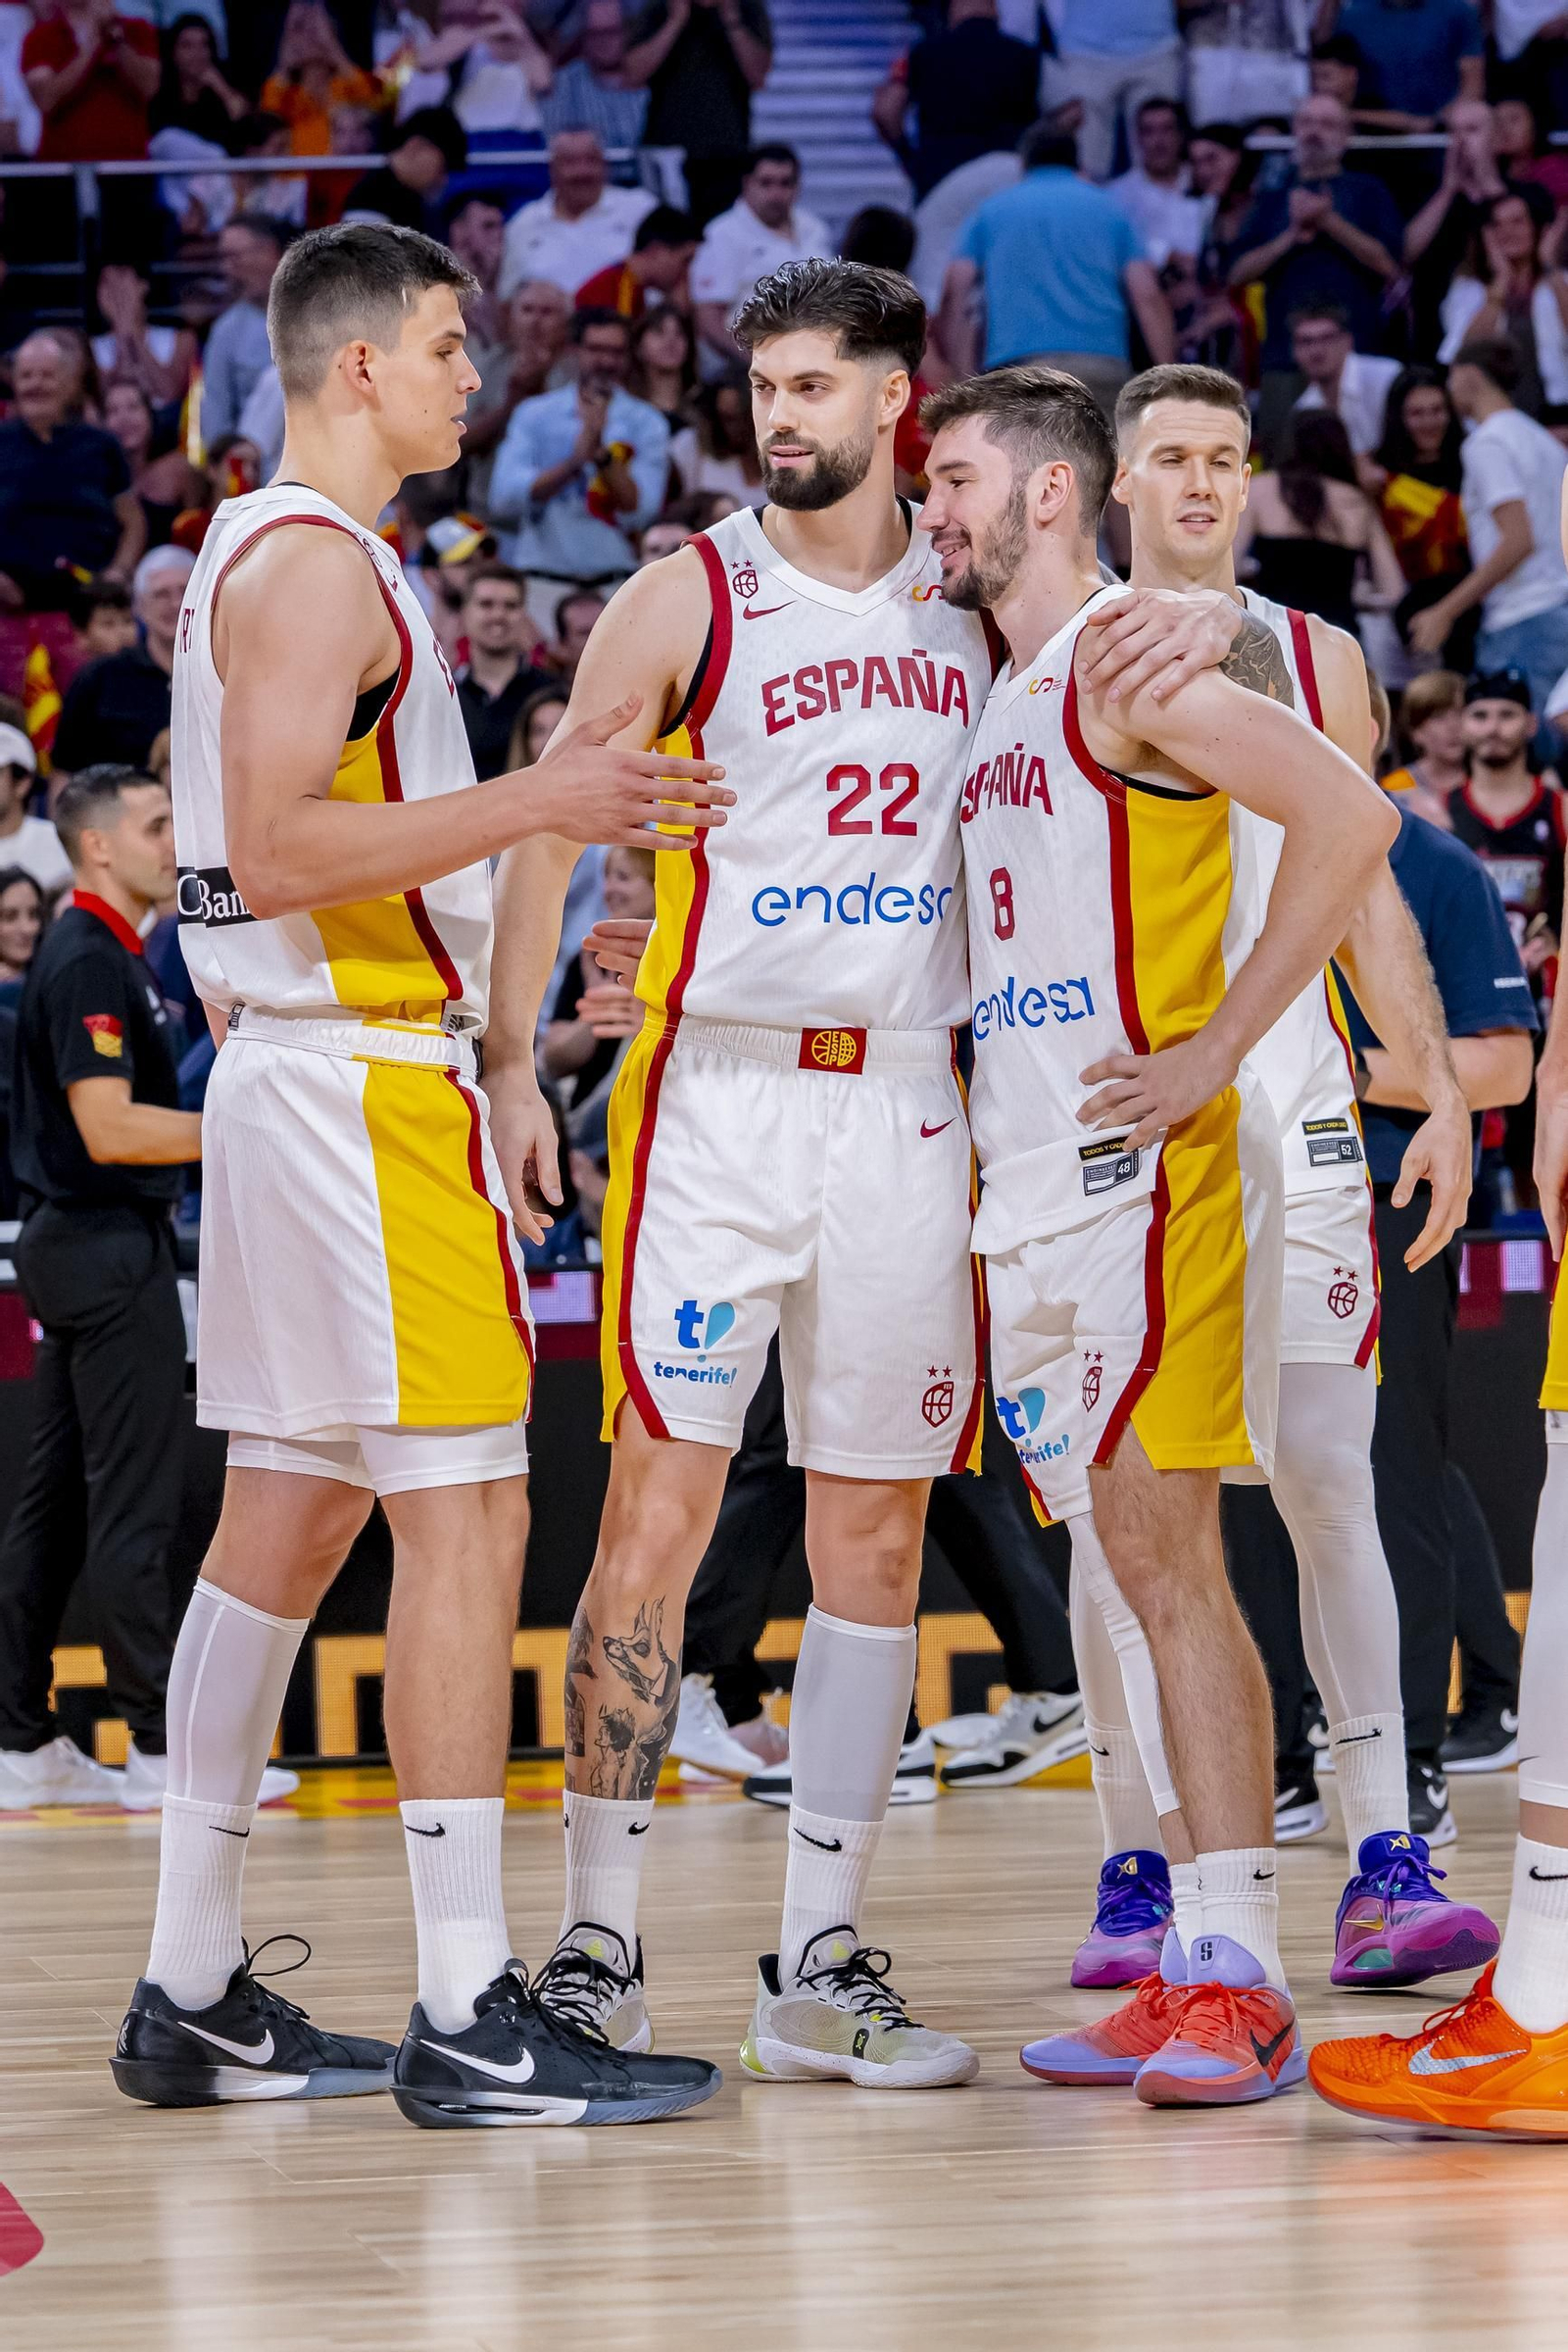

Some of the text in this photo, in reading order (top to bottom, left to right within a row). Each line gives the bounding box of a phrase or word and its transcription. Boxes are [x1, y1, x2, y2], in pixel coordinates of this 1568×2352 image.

[761, 649, 968, 737] ESPAÑA
[826, 763, 919, 836] 22
[960, 742, 1054, 824] SPAÑA
[989, 866, 1015, 941] 8
[973, 976, 1096, 1041] endesa
[828, 1030, 840, 1066] ESP
[1117, 1161, 1130, 1175] 48
[1341, 1144, 1352, 1155] 52
